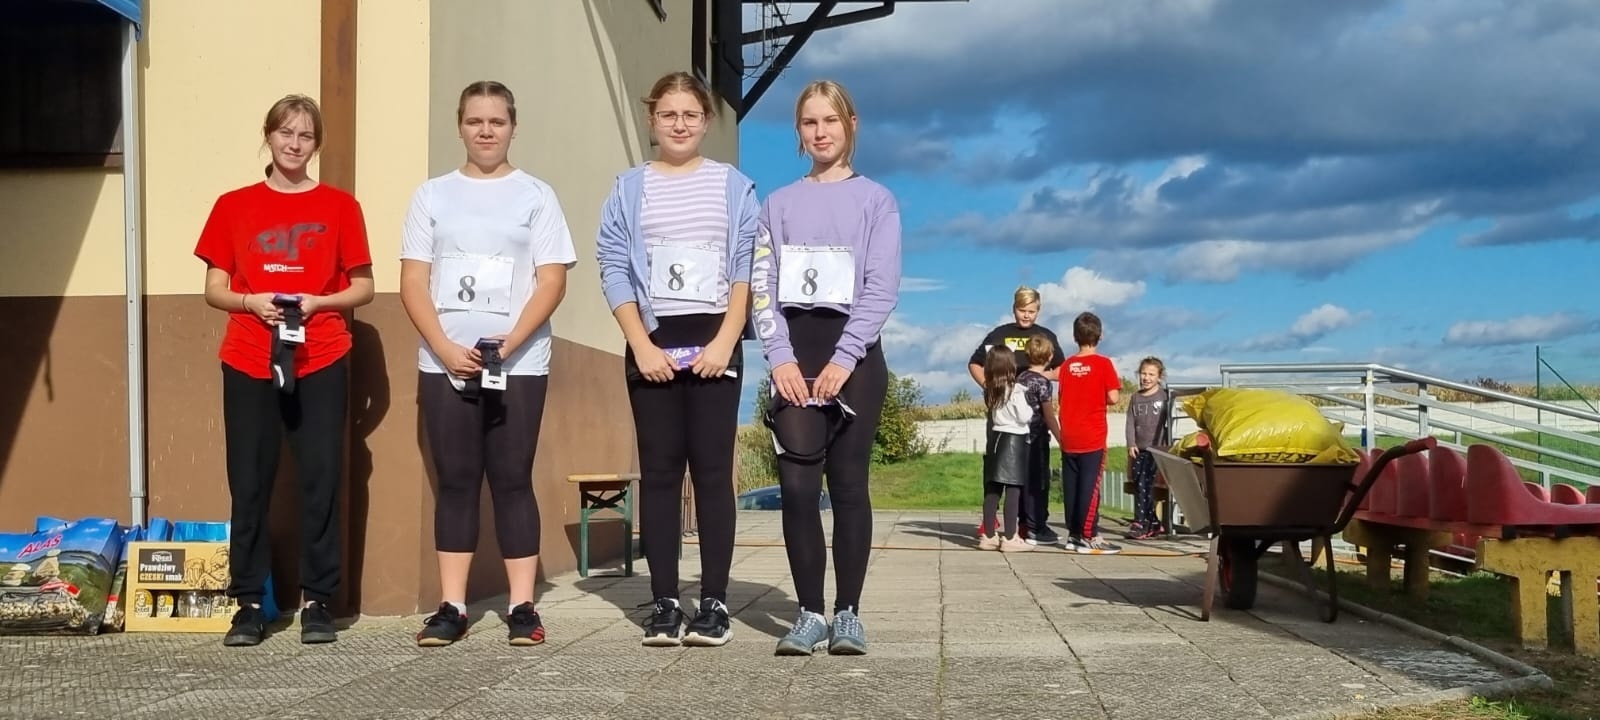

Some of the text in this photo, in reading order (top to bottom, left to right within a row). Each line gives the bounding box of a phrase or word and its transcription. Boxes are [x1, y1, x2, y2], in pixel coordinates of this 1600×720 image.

[457, 275, 476, 303] 8
[667, 263, 685, 291] 8
[801, 267, 818, 297] 8
[17, 533, 63, 559] ALAS
[139, 563, 176, 573] Prawdziwy
[139, 573, 183, 581] CZESKI smak
